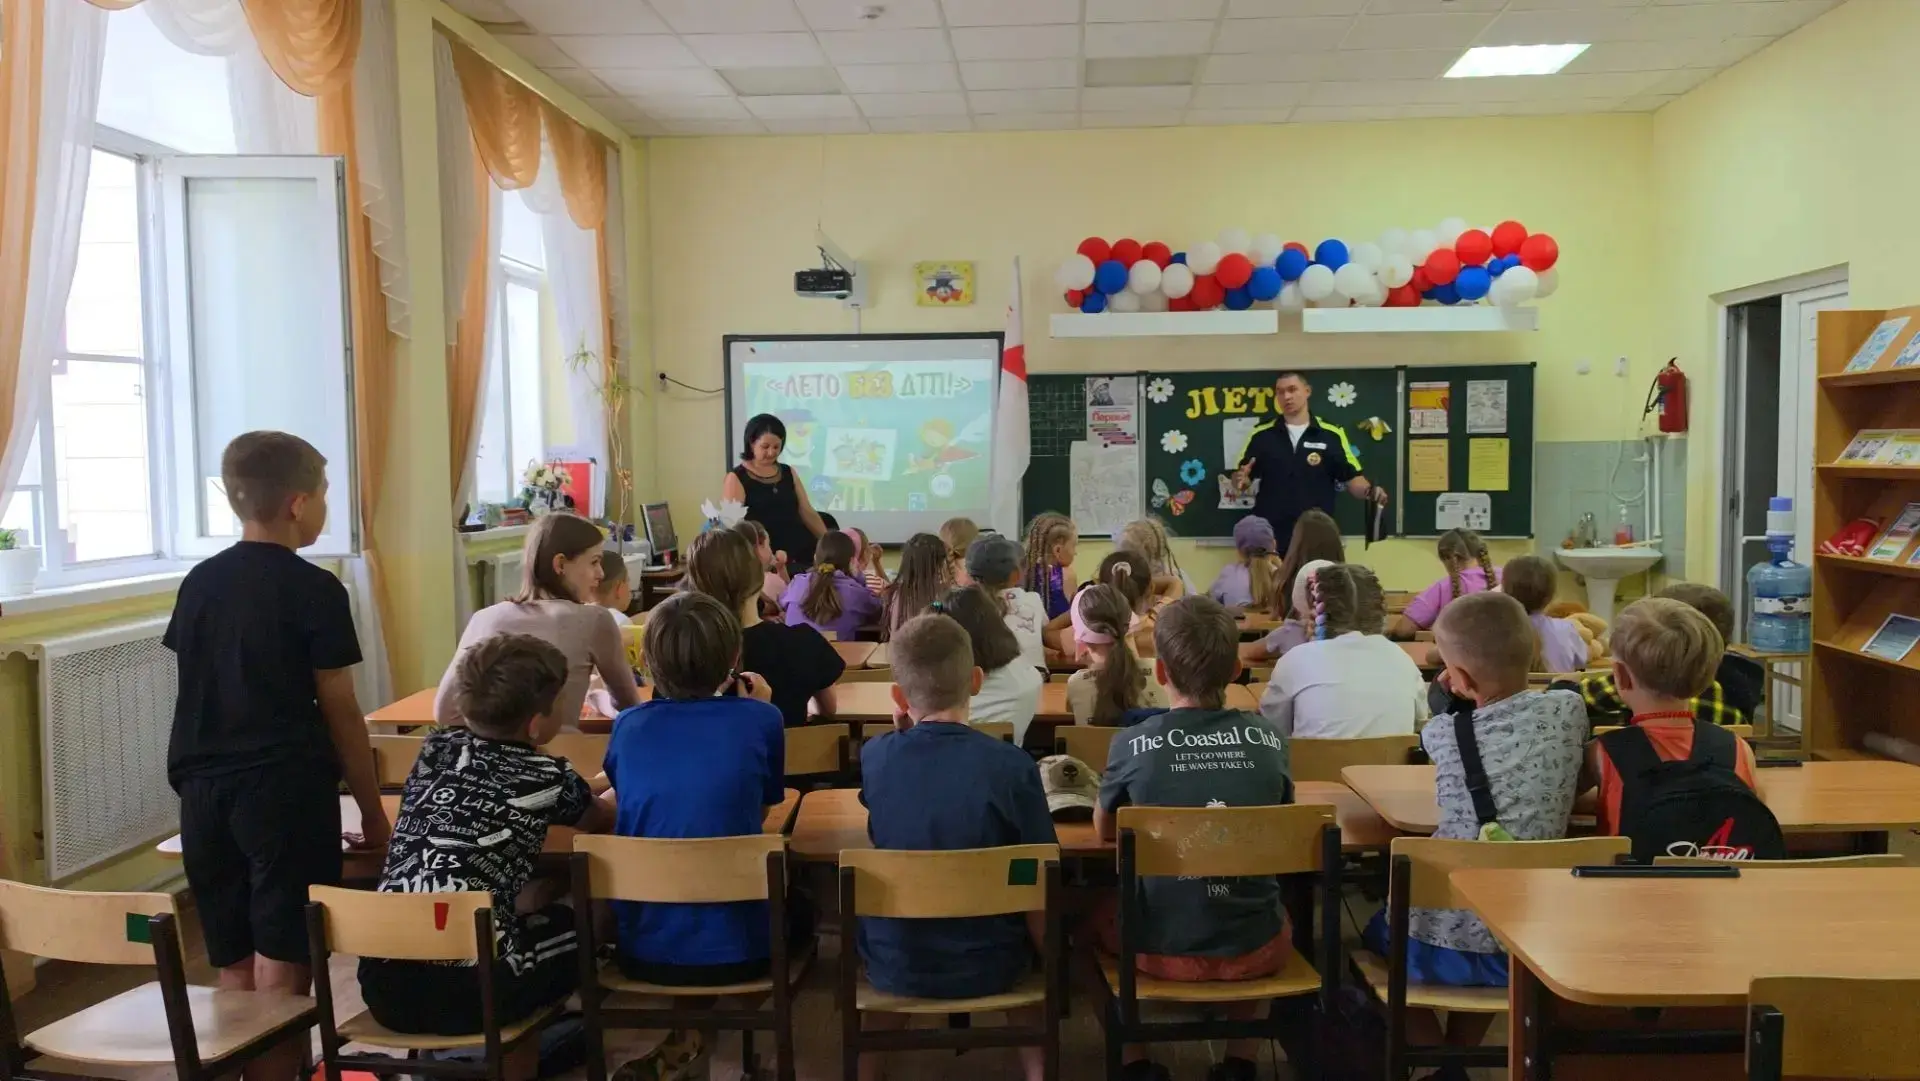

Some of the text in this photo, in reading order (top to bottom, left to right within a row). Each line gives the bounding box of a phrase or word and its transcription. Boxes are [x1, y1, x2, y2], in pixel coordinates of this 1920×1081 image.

[1186, 387, 1284, 419] ЛЕТ
[1129, 726, 1281, 757] The Coastal Club
[1170, 760, 1255, 772] THE WAVES TAKE US
[1175, 751, 1246, 761] LET'S GO WHERE
[461, 796, 506, 816] LAZY
[422, 848, 462, 869] YES
[1206, 884, 1230, 897] 1998
